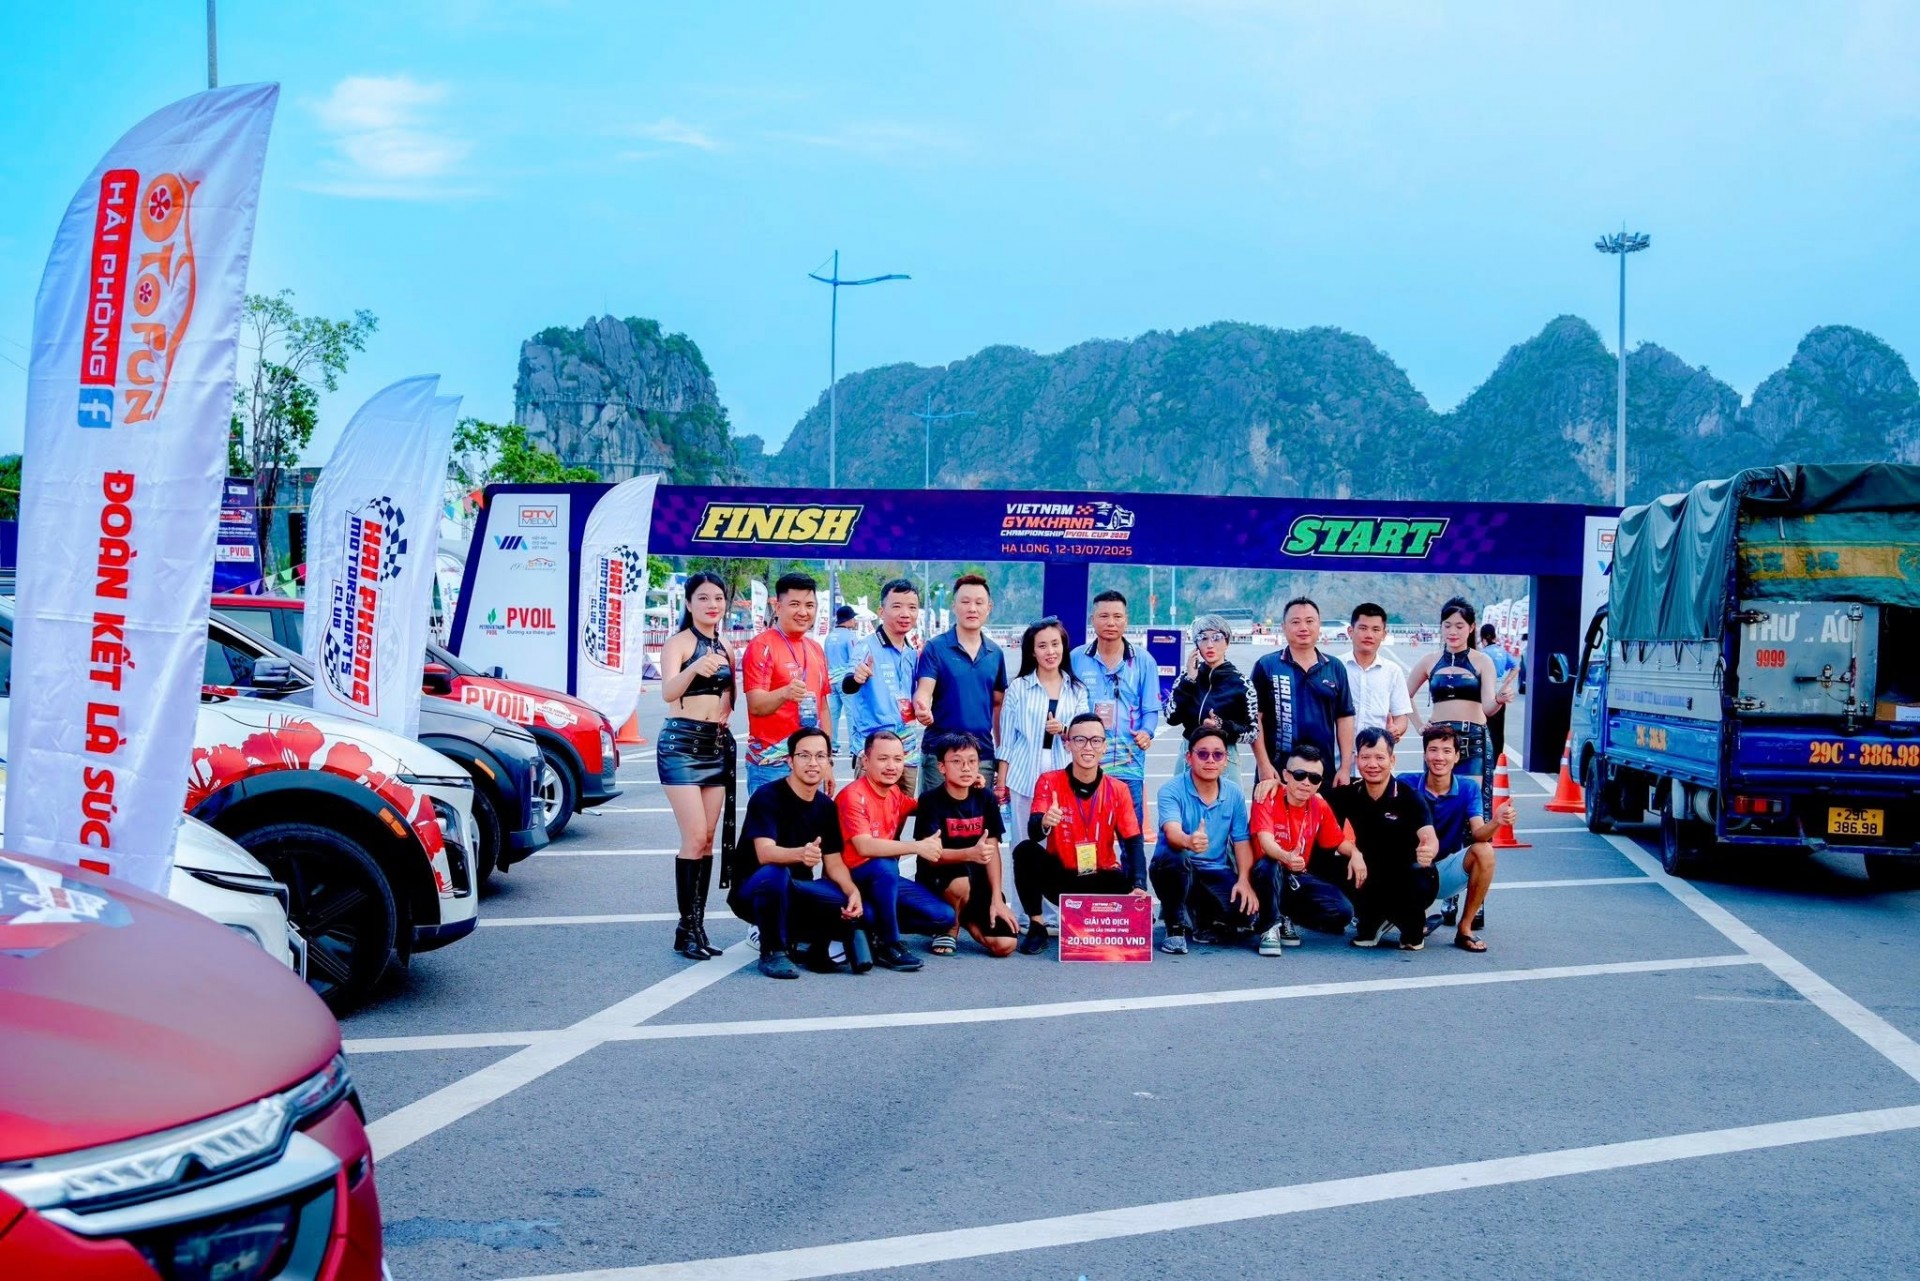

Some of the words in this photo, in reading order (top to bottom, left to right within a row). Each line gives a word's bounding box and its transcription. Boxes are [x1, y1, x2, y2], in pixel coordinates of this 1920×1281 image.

[102, 181, 127, 241] HẢI
[89, 254, 117, 377] PHÒNG
[521, 518, 556, 526] MEDIA
[1006, 503, 1074, 515] VIETNAM
[95, 470, 139, 600] ĐOÀN
[699, 507, 857, 543] FINISH
[1000, 529, 1064, 537] CHAMPIONSHIP
[1065, 530, 1090, 538] PVOIL
[1002, 516, 1095, 529] GYMKHANA
[1286, 518, 1443, 554] START
[229, 547, 252, 557] PVOIL
[361, 519, 382, 582] HAI
[1001, 544, 1017, 553] HA
[1020, 544, 1053, 555] LONG,
[1055, 544, 1133, 556] 12-13/07/2025
[333, 585, 344, 629] CLUB
[340, 516, 361, 676] MOTORSPORTS
[598, 557, 609, 651] MOTORSPORTS
[507, 607, 556, 629] PVOIL
[590, 598, 598, 624] CLUB
[89, 612, 135, 691] KẾT
[1756, 649, 1786, 668] 9999
[465, 687, 530, 722] PVOIL
[84, 702, 128, 754] LÀ
[1809, 741, 1844, 764] 29C
[1860, 743, 1920, 767] 386.98
[79, 765, 123, 849] SỨC
[1844, 809, 1868, 821] 29C
[1834, 821, 1878, 834] 386.98
[1084, 916, 1099, 926] GIẢI
[1112, 918, 1130, 927] ĐỊCH
[1067, 936, 1124, 946] 20.000.000
[1125, 936, 1146, 946] VND
